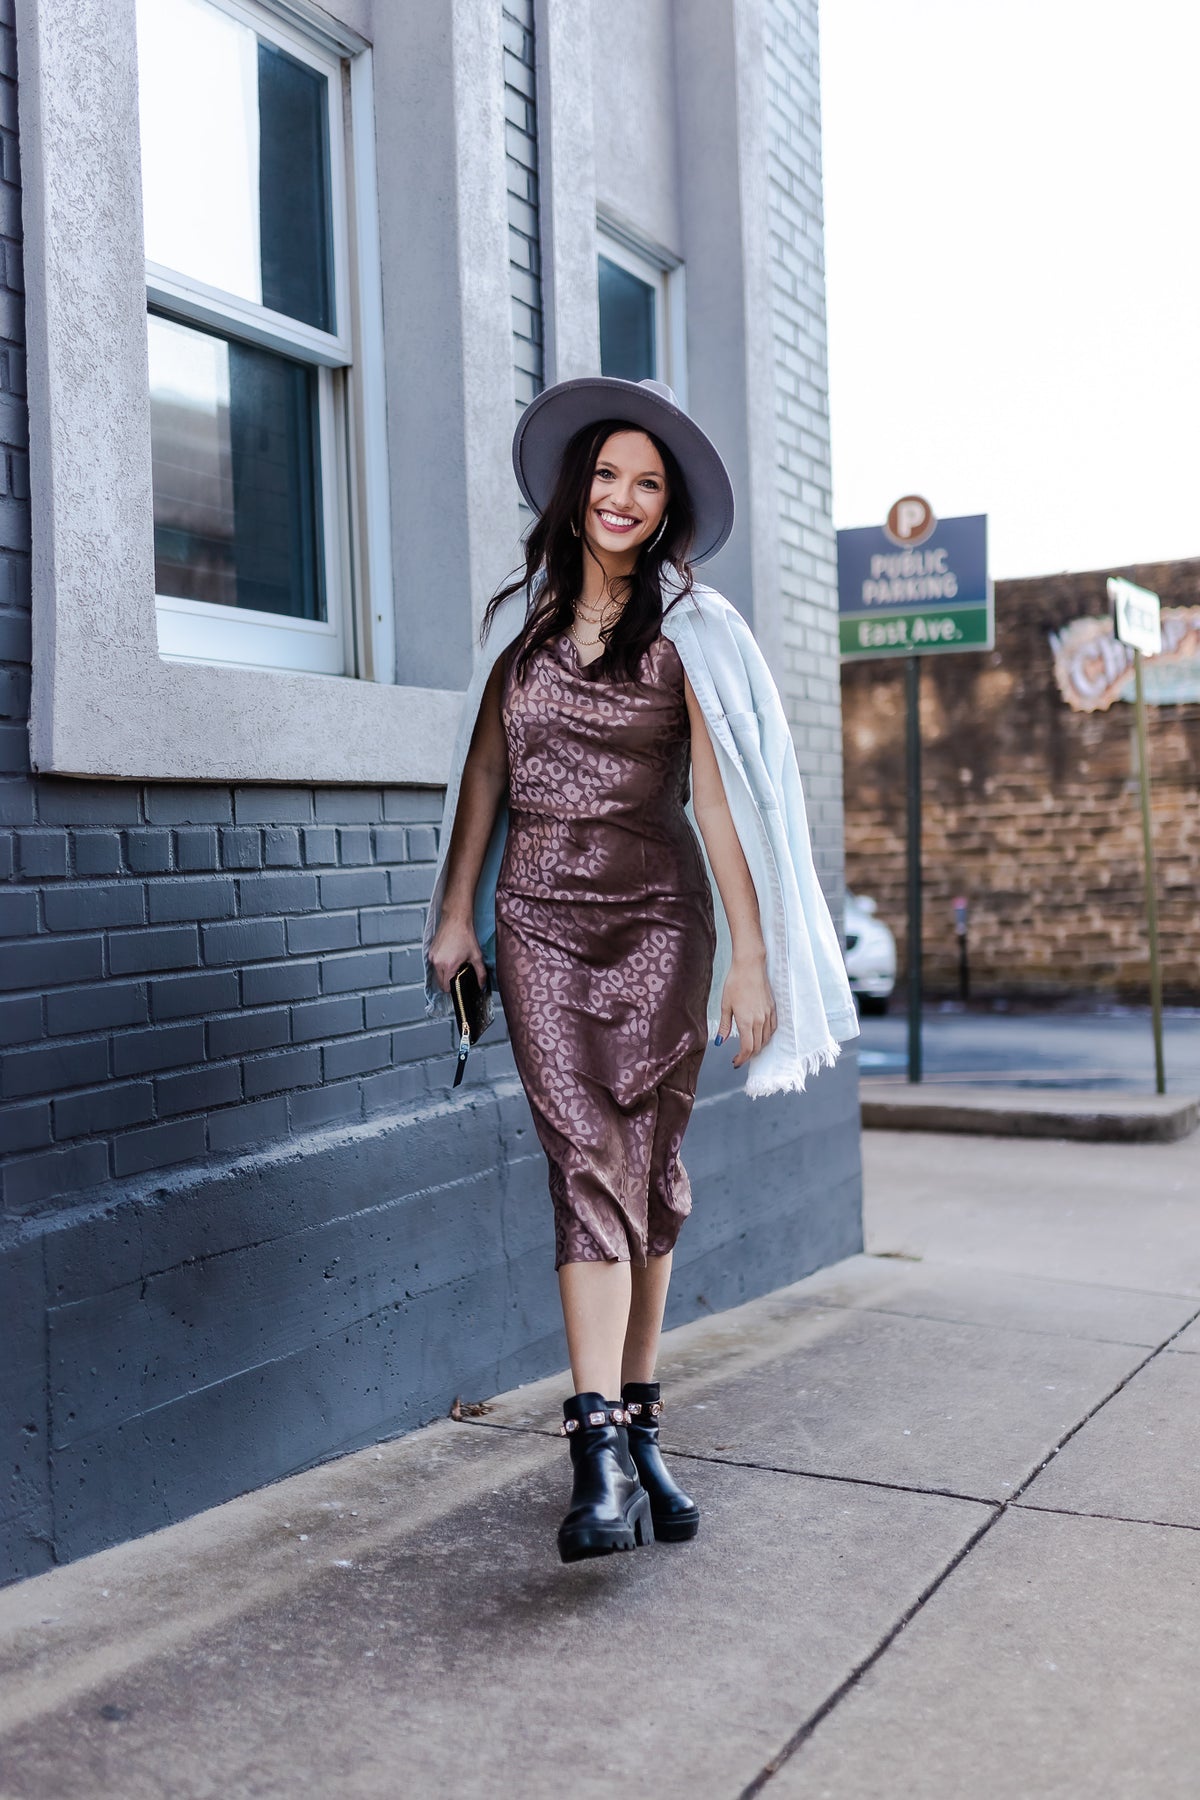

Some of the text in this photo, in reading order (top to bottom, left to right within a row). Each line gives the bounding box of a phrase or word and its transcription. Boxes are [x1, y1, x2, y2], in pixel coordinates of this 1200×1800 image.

[897, 501, 926, 538] P
[870, 549, 949, 579] PUBLIC
[861, 572, 958, 605] PARKING
[858, 617, 963, 647] East Ave.
